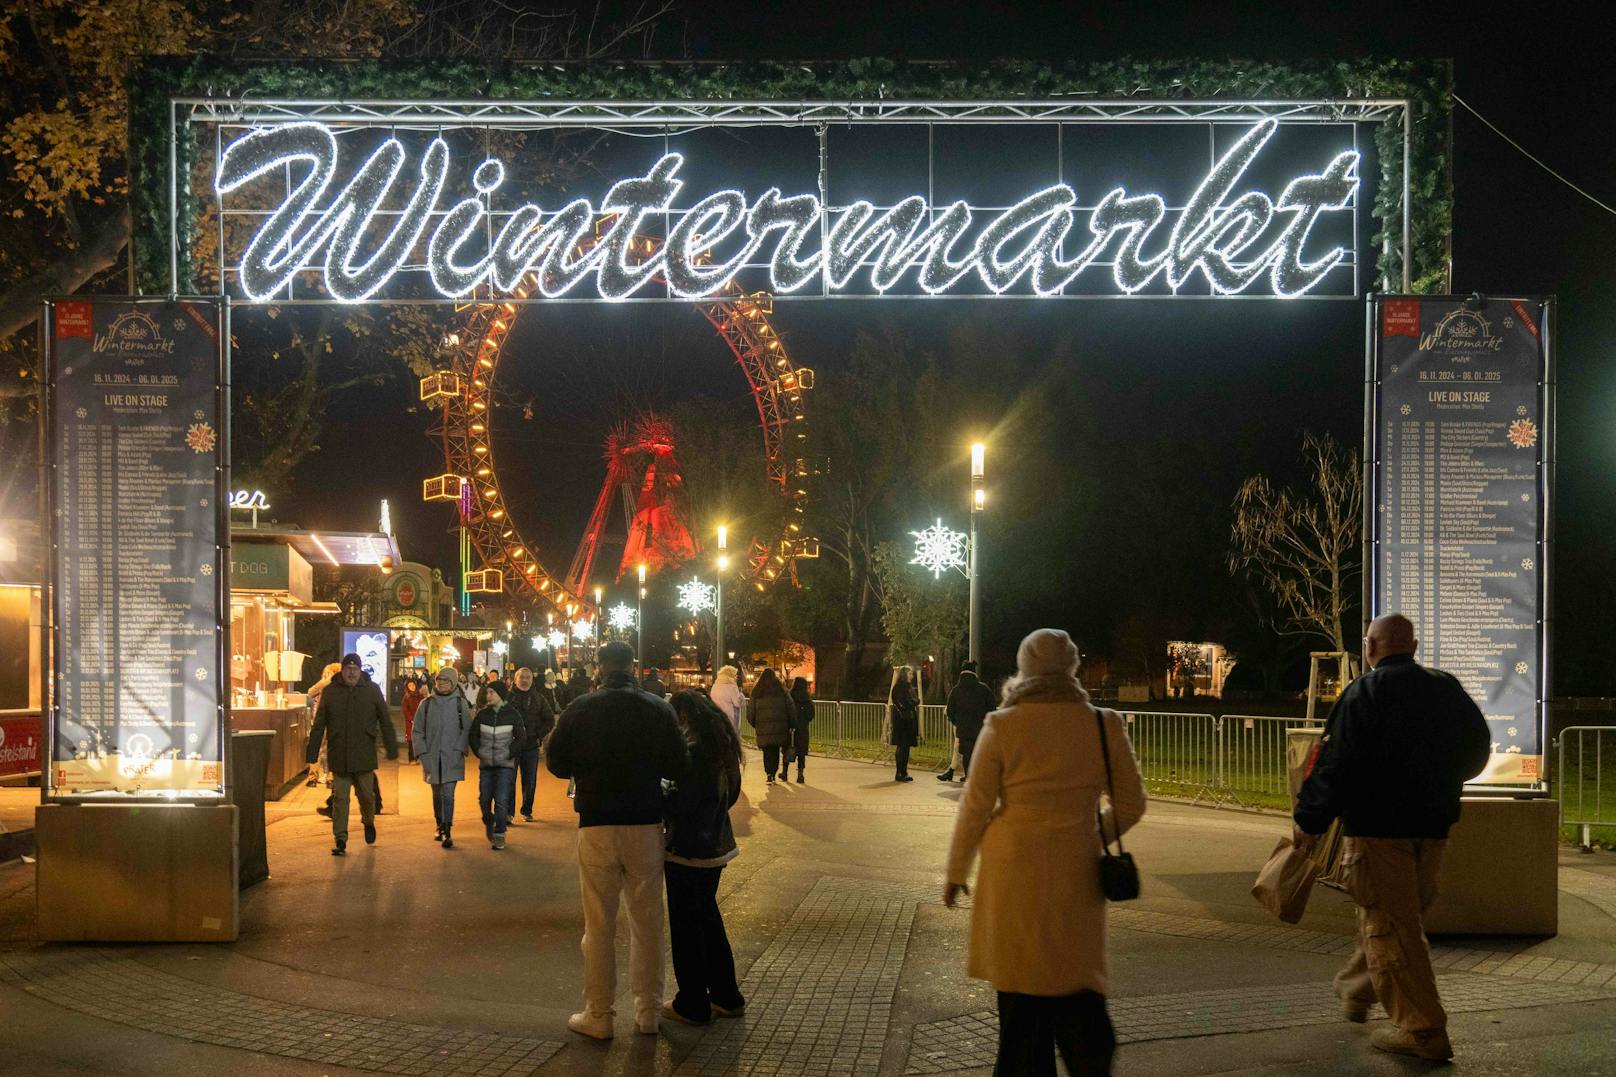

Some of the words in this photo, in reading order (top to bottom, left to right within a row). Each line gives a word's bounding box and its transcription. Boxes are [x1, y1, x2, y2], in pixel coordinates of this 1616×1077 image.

[215, 116, 1361, 304] Wintermarkt
[93, 333, 175, 354] Wintermarkt
[1419, 331, 1504, 351] Wintermarkt
[114, 375, 130, 384] 2024
[161, 376, 178, 384] 2025
[1420, 371, 1429, 380] 16.
[1438, 371, 1455, 380] 2024
[1484, 372, 1500, 380] 2025
[104, 394, 124, 406] LIVE
[126, 395, 138, 406] ON
[140, 396, 168, 406] STAGE
[1428, 392, 1447, 402] LIVE
[1448, 392, 1462, 402] ON
[1464, 392, 1490, 402] STAGE
[240, 562, 268, 574] DOG
